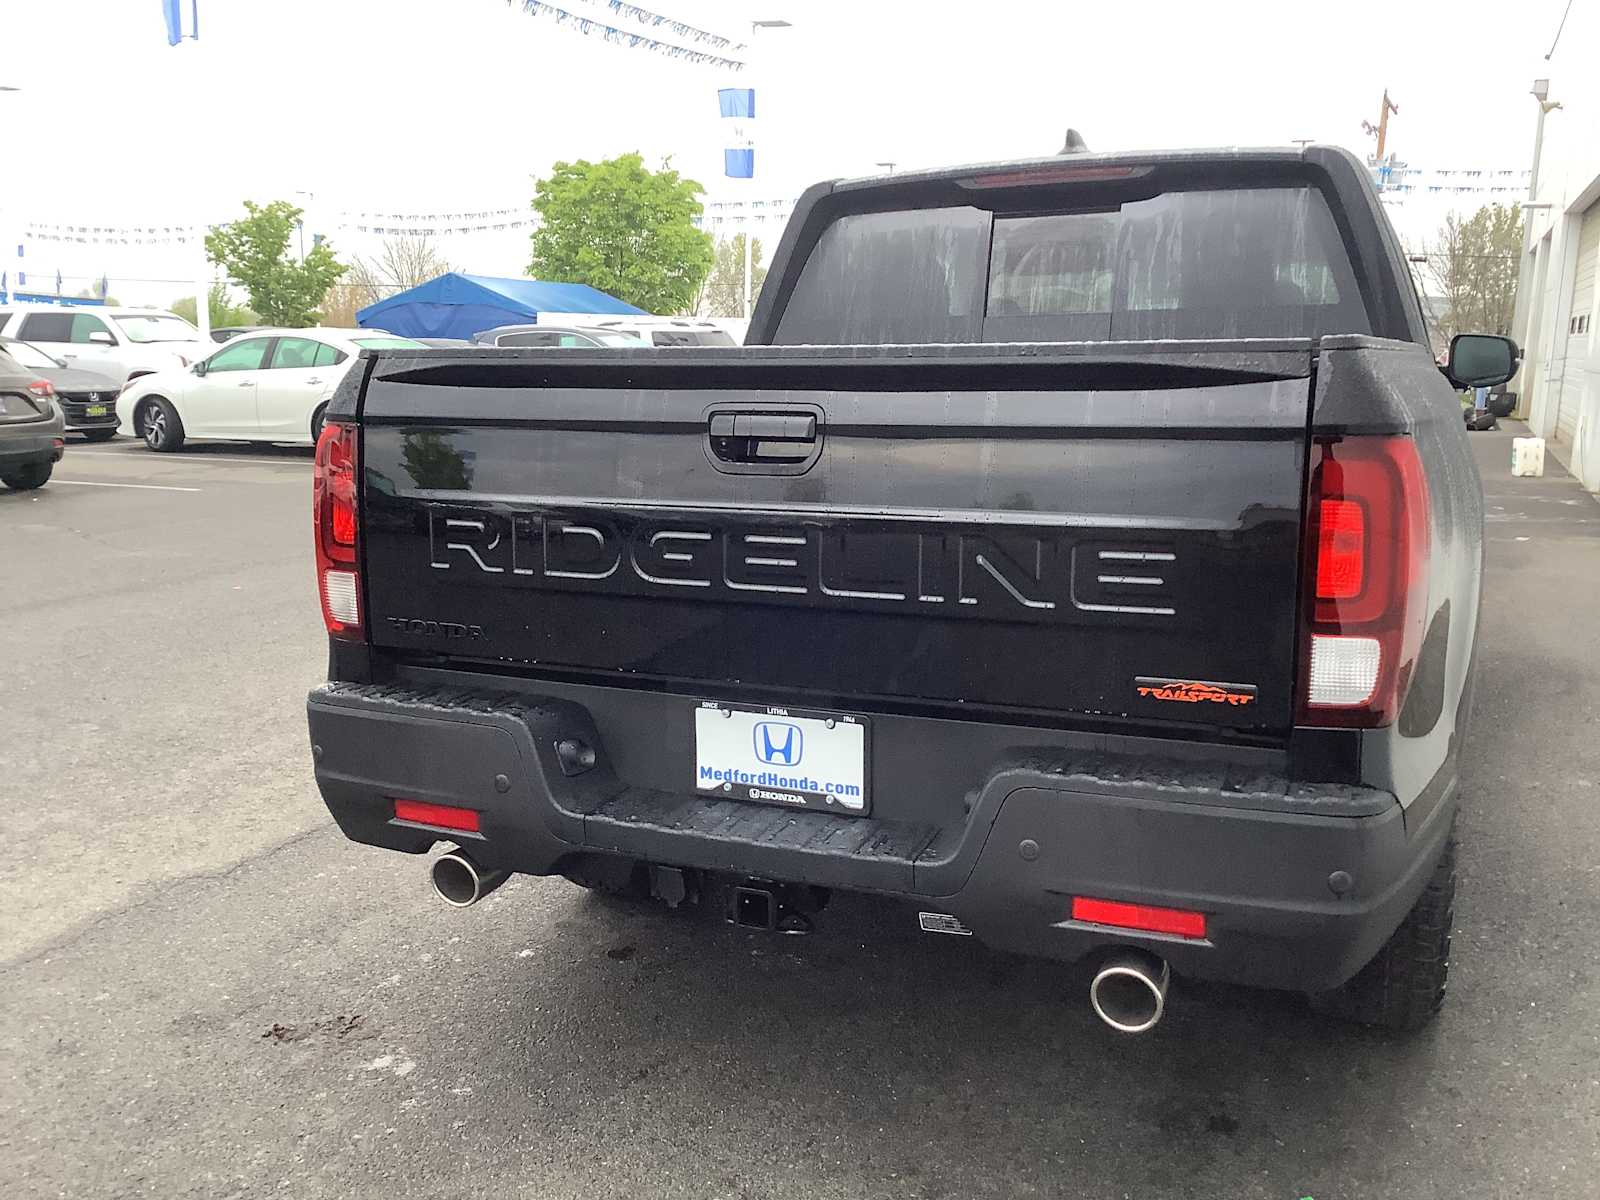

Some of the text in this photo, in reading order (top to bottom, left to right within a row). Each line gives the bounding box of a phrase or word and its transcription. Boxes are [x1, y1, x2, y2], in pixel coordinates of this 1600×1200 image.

[428, 508, 1178, 616] RIDGELINE
[386, 616, 489, 642] HONDA
[1136, 686, 1254, 706] TRAILSPORT
[701, 701, 719, 709] SINCE
[766, 707, 789, 717] LITHIA
[699, 765, 860, 797] MedfordHonda.com
[759, 791, 807, 804] HONDA
